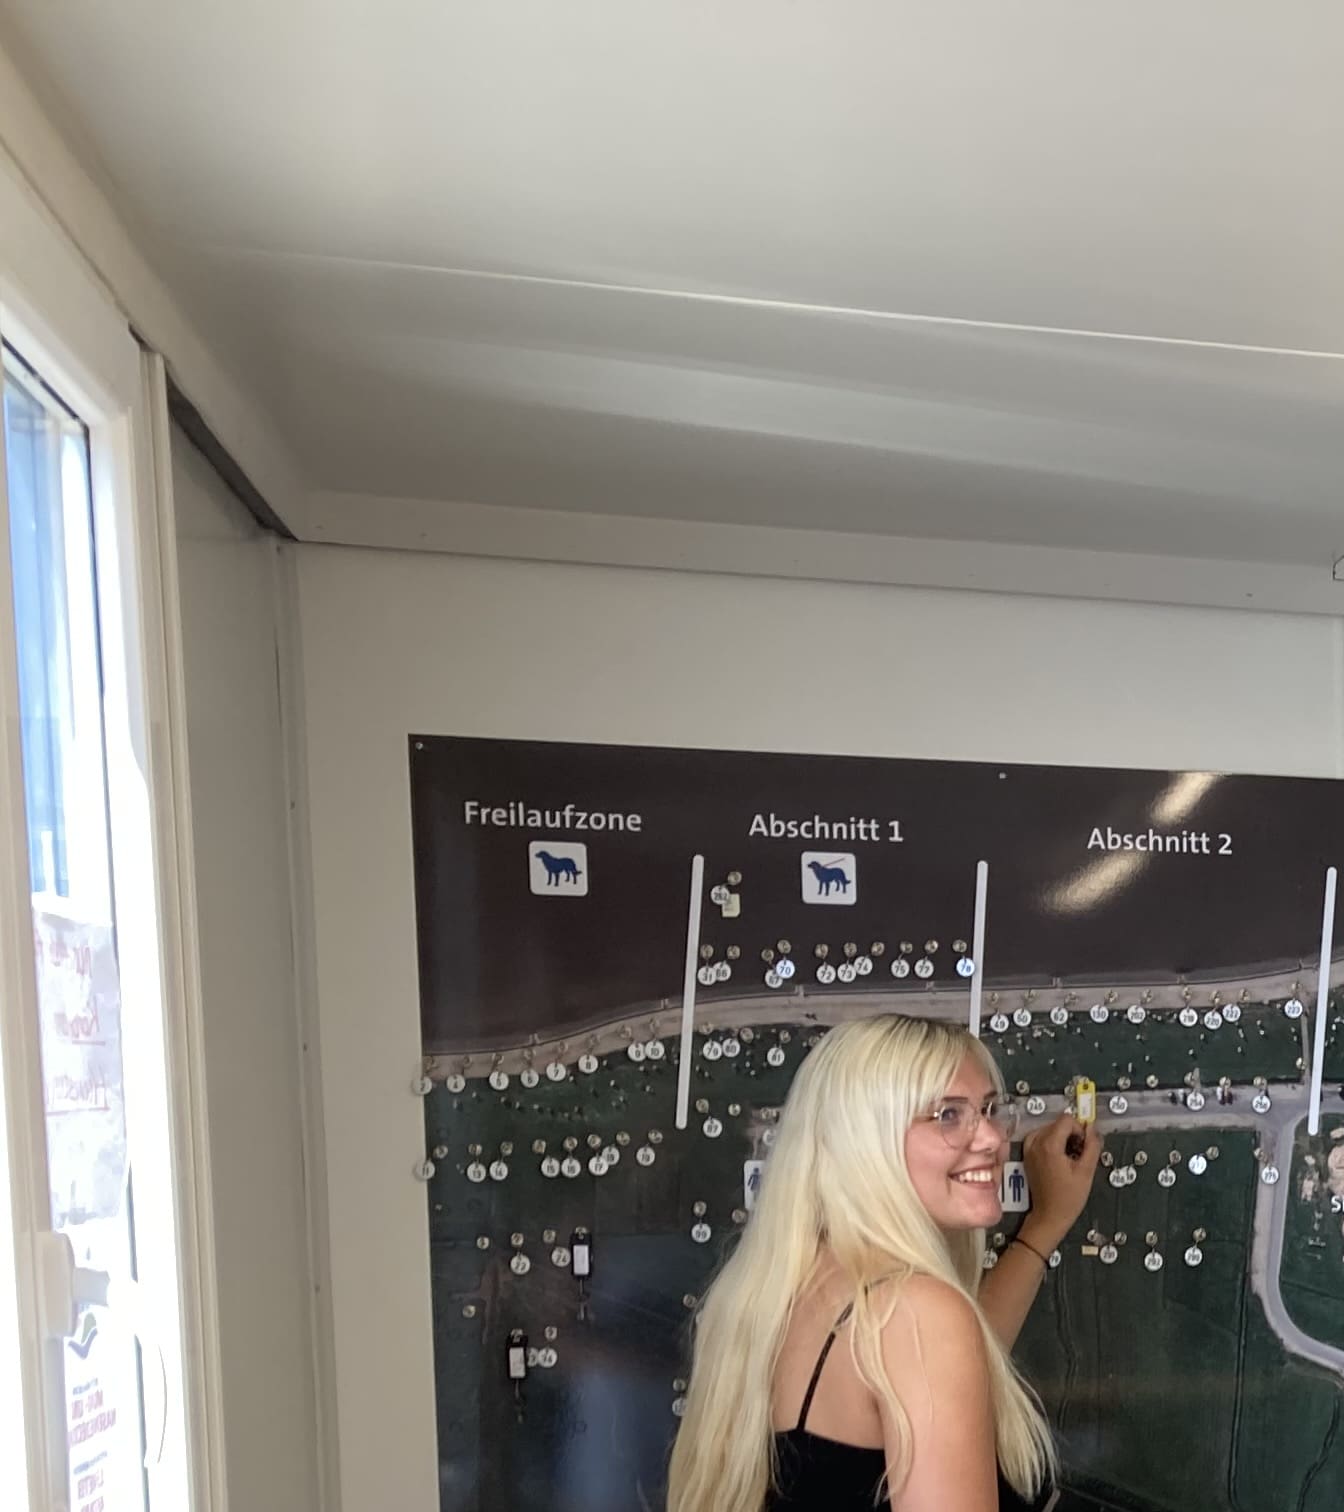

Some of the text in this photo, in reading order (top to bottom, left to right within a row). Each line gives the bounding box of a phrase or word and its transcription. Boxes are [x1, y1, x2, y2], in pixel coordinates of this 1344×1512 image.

[464, 801, 642, 832] Freilaufzone
[748, 813, 904, 842] Abschnitt 1
[1087, 826, 1233, 854] Abschnitt 2
[779, 966, 791, 976] 70
[841, 969, 853, 979] 73
[919, 964, 930, 974] 77
[821, 970, 832, 980] 72
